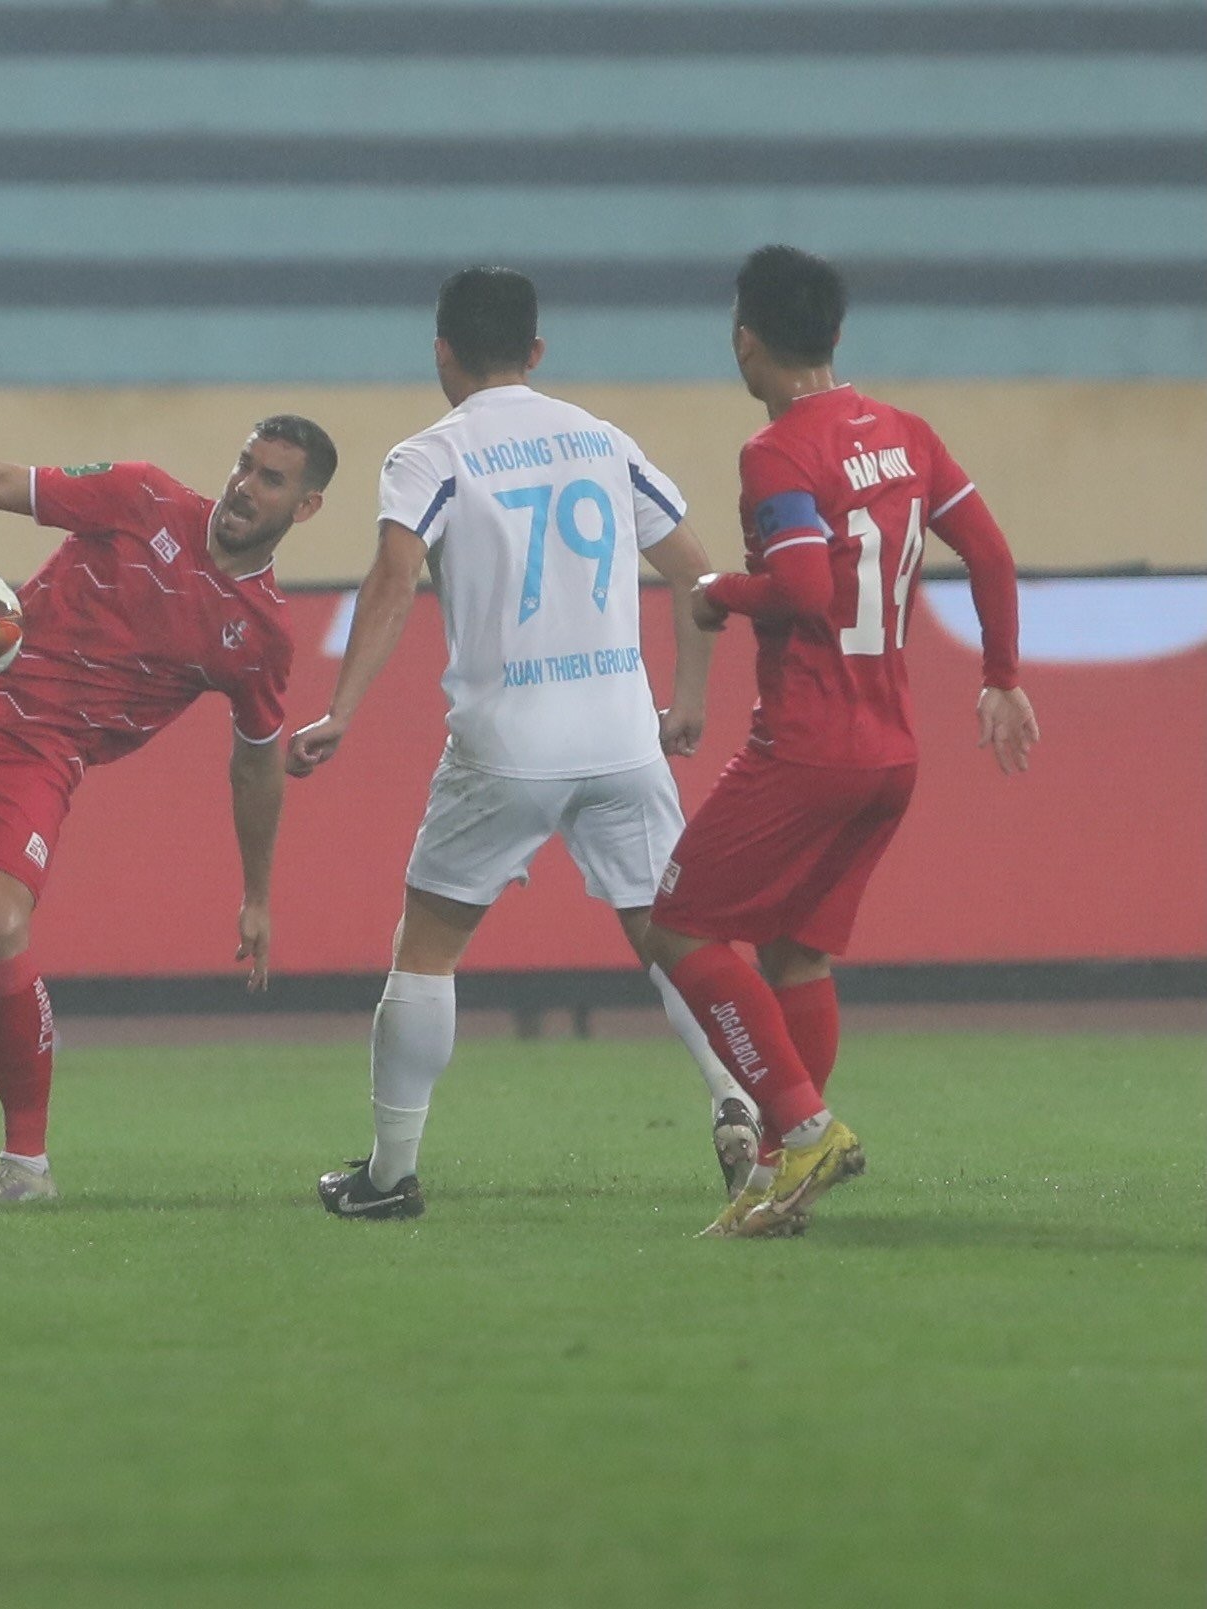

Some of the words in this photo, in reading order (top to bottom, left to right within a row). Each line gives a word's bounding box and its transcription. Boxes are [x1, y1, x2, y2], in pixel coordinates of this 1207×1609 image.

[552, 431, 614, 464] THỊNH
[492, 479, 616, 626] 79
[840, 497, 923, 655] 14
[503, 658, 543, 688] XUAN
[545, 653, 592, 681] THIEN
[595, 647, 640, 676] GROUP
[710, 1001, 770, 1084] JOGARBOLA
